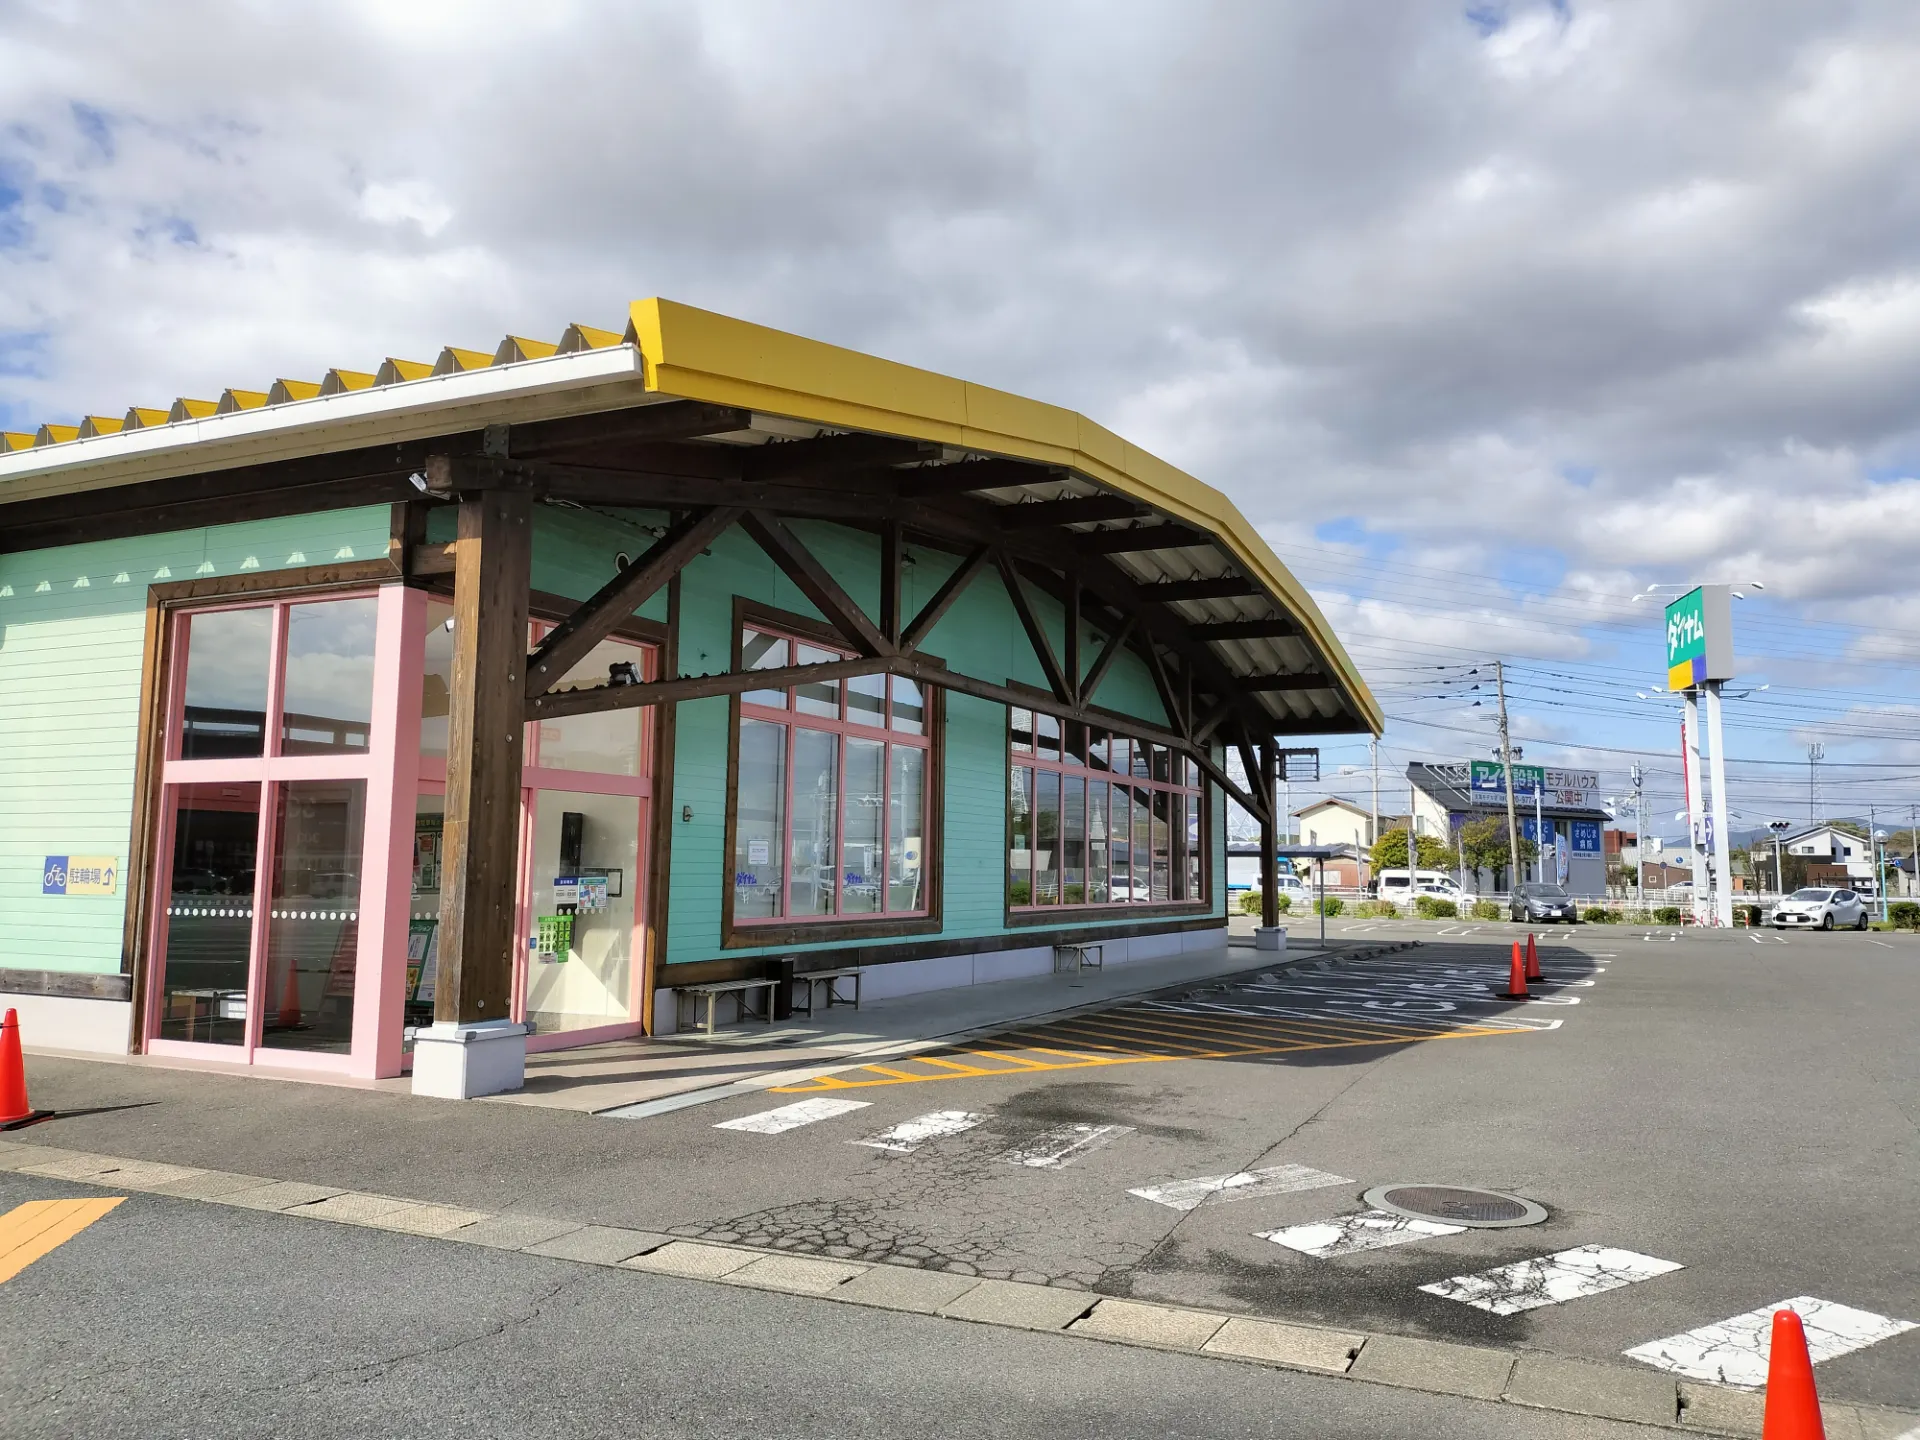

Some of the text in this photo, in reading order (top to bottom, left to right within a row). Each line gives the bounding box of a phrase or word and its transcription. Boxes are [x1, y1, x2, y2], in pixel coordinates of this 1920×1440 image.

[1668, 609, 1704, 660] ダイナム
[1546, 772, 1598, 789] モデルハウス
[1575, 829, 1597, 838] さめじま
[1579, 839, 1593, 850] 病院
[69, 868, 101, 884] 駐輪場
[736, 872, 757, 887] ダイナム
